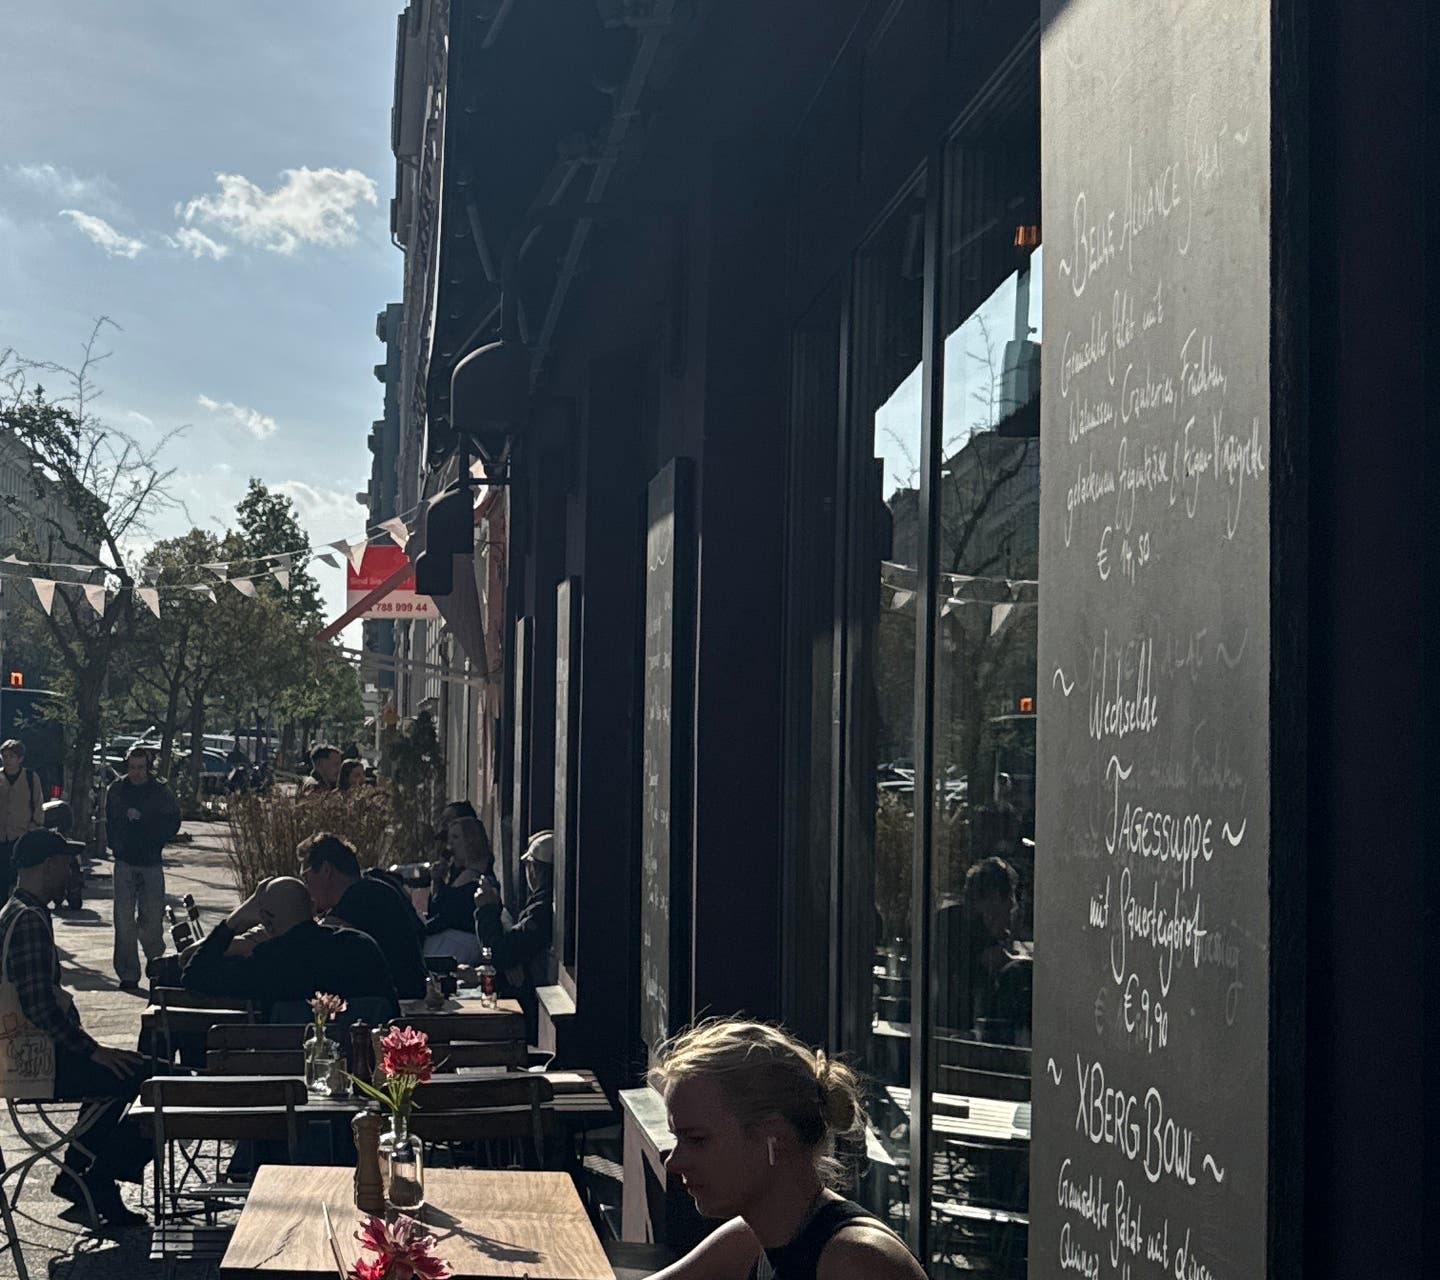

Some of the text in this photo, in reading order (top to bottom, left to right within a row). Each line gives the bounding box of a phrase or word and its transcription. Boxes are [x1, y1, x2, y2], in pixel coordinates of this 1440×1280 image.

[1097, 525, 1112, 581] €
[1105, 754, 1214, 892] TAGESSUPPE
[1090, 875, 1111, 929] mit
[1111, 867, 1207, 997] Sauerteigbrot
[1147, 1218, 1170, 1270] mit
